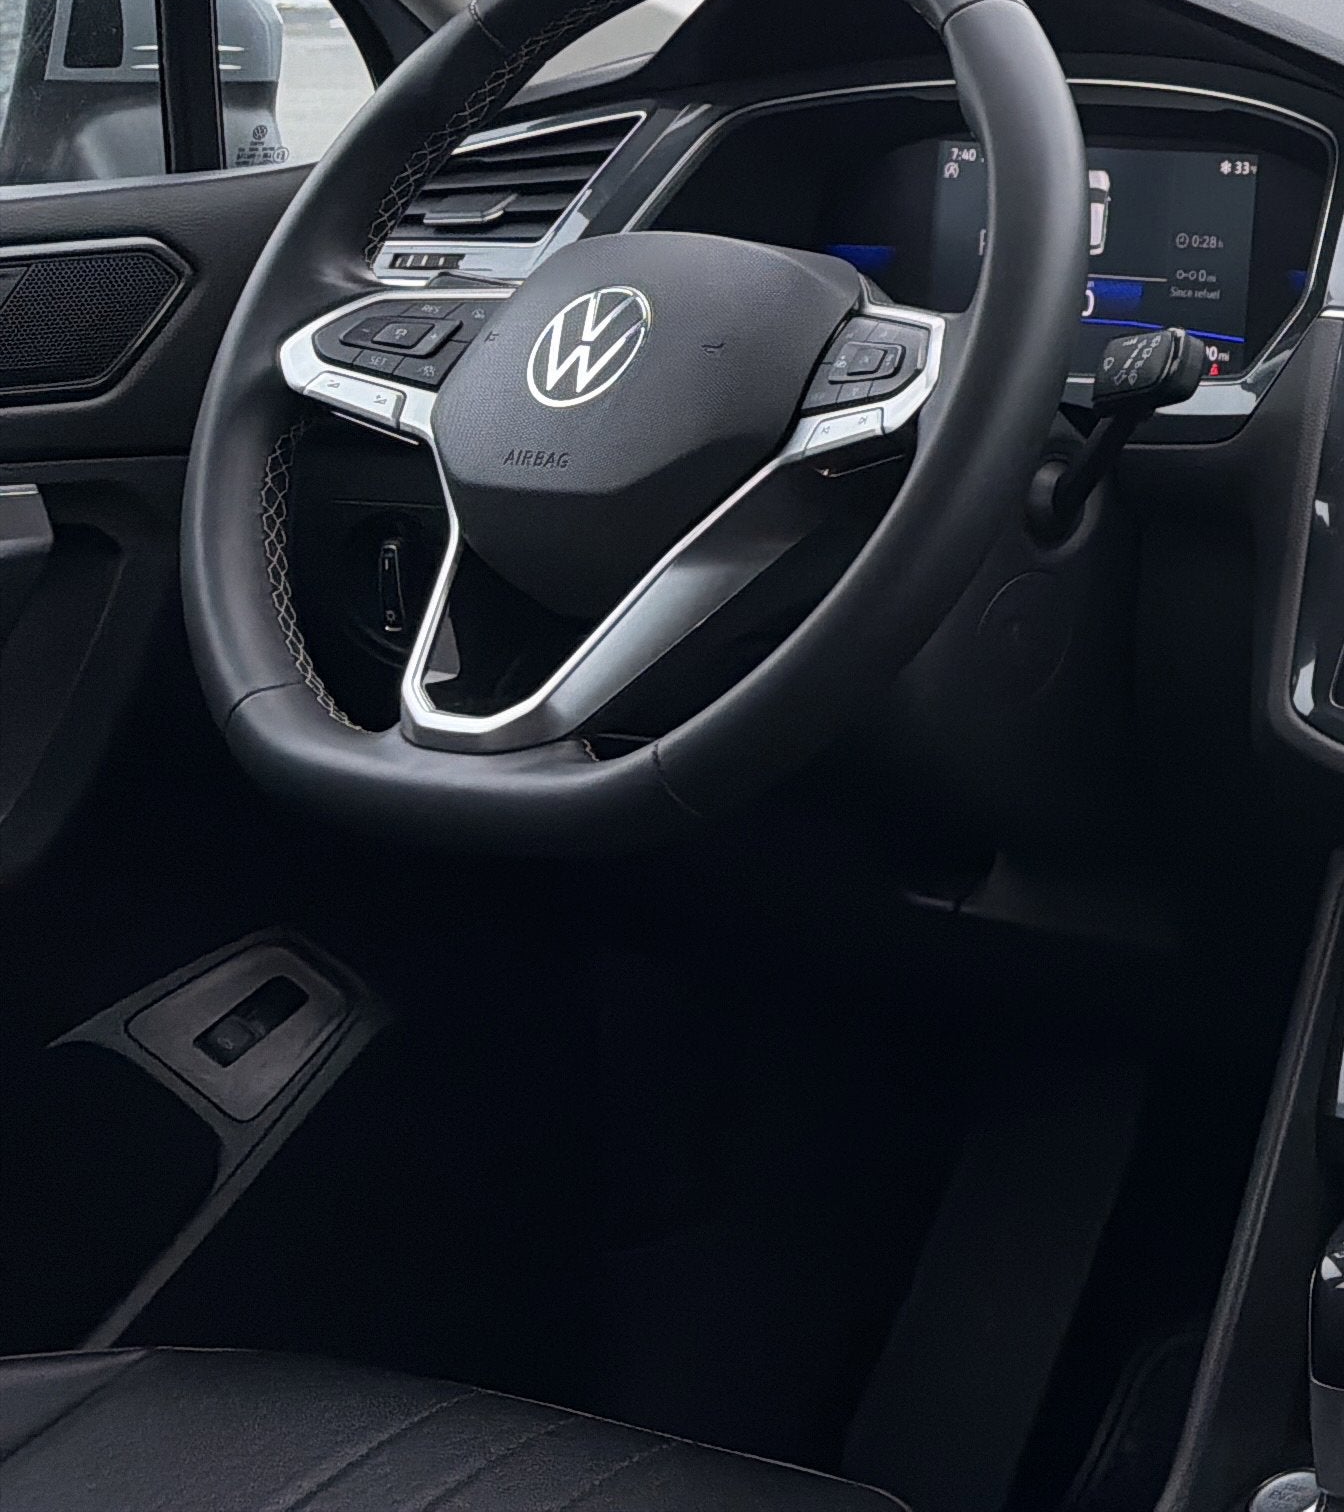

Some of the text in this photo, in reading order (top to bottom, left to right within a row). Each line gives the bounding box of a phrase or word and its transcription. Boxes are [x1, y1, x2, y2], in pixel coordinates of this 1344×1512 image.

[950, 147, 977, 162] 7:40
[368, 355, 388, 366] SET
[503, 450, 570, 470] AIRBAG
